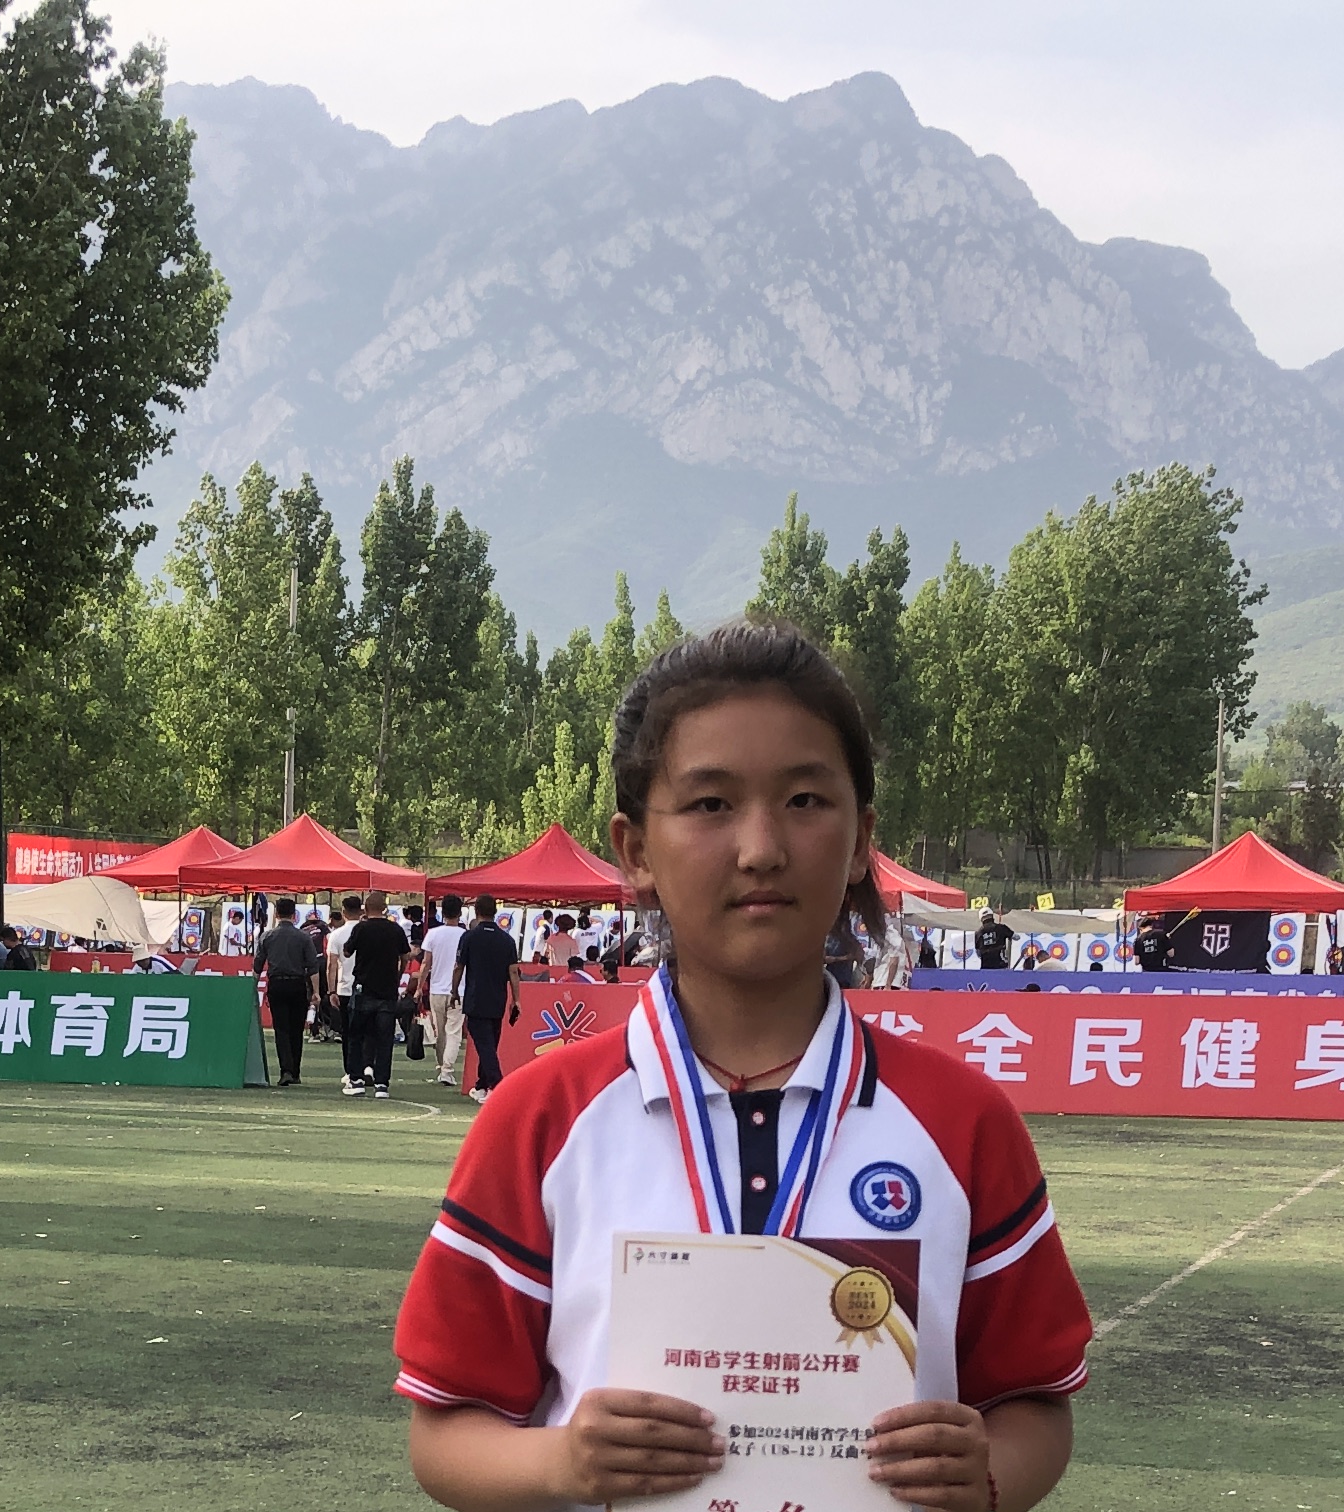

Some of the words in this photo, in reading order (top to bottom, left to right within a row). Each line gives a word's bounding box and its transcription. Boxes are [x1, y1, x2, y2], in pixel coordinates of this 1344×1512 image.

[1040, 896, 1052, 908] 21
[664, 1348, 861, 1373] 河南省学生射箭公开赛
[722, 1374, 800, 1394] 获奖证书
